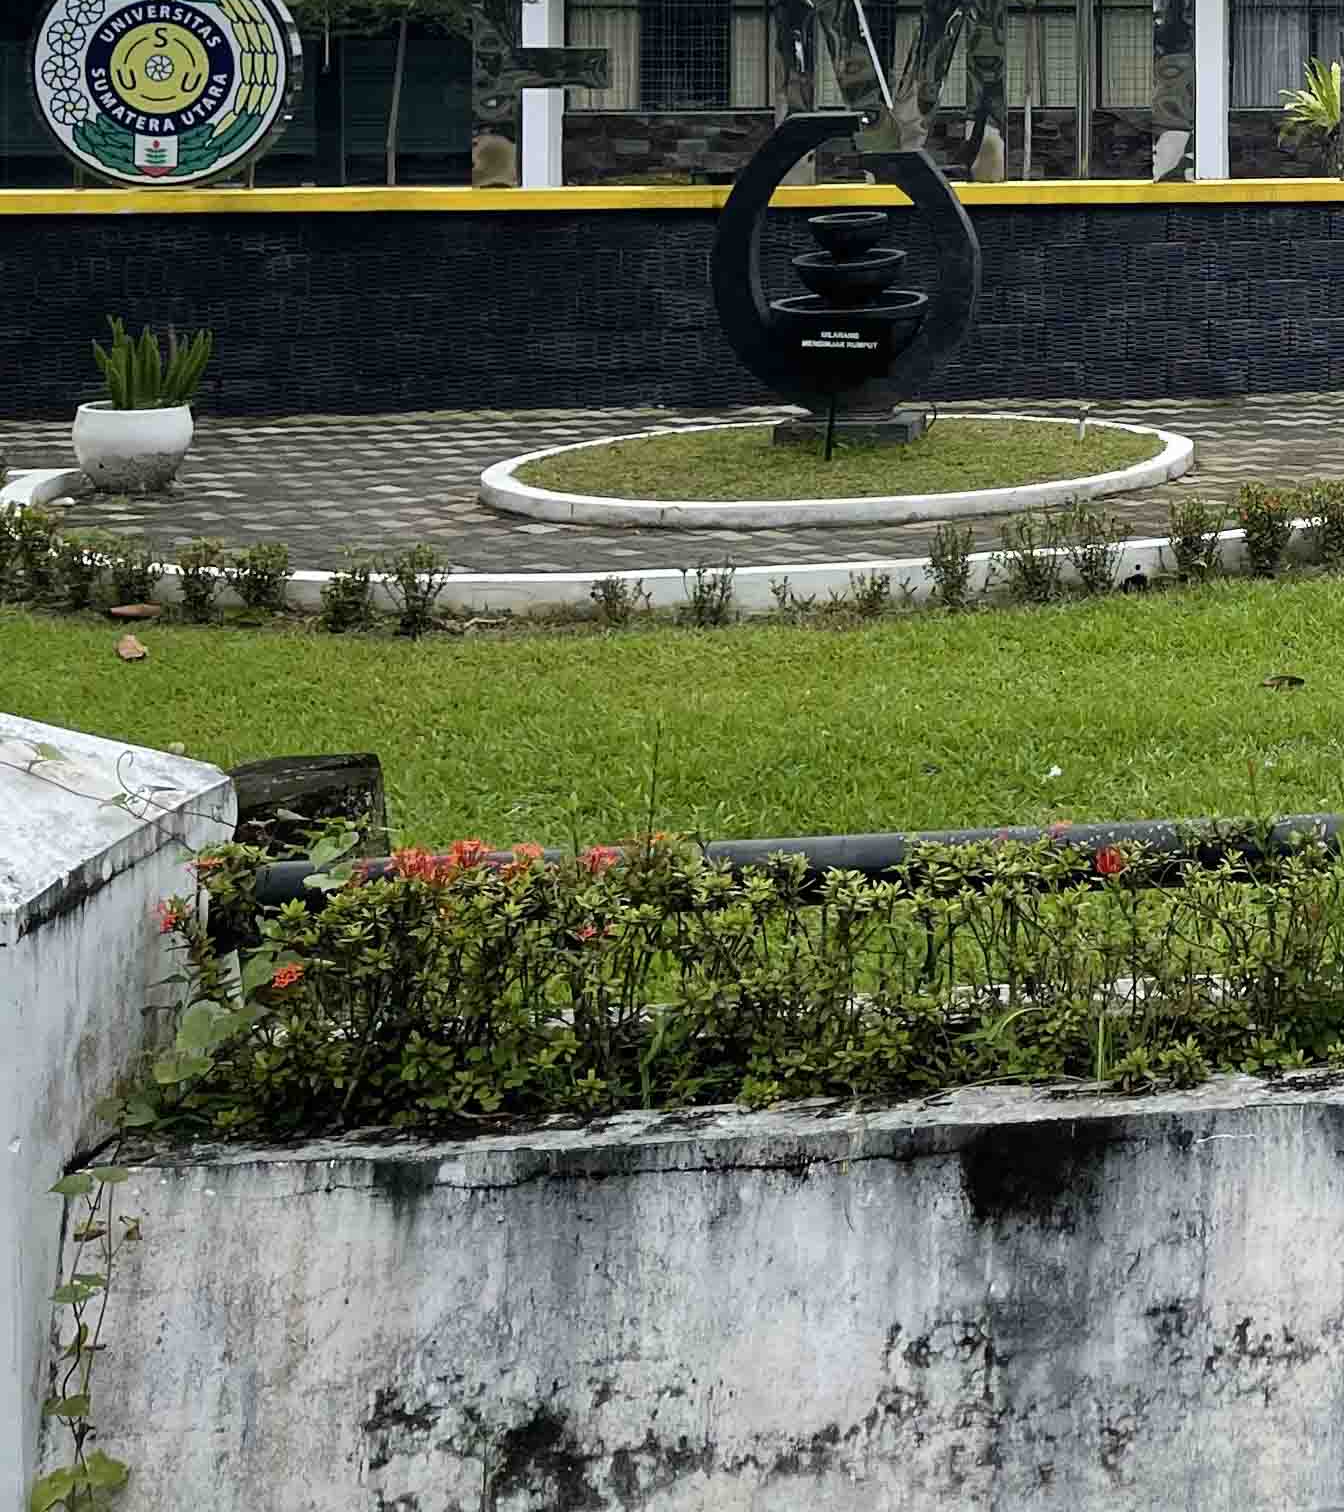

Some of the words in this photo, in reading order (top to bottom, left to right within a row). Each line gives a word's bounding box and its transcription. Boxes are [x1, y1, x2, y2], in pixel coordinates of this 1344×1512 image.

[99, 5, 222, 48] UNIVERSITAS
[154, 28, 168, 48] S
[117, 69, 136, 90] U
[181, 72, 202, 93] U
[91, 67, 175, 132] SUMATERA
[181, 72, 228, 126] UTARA
